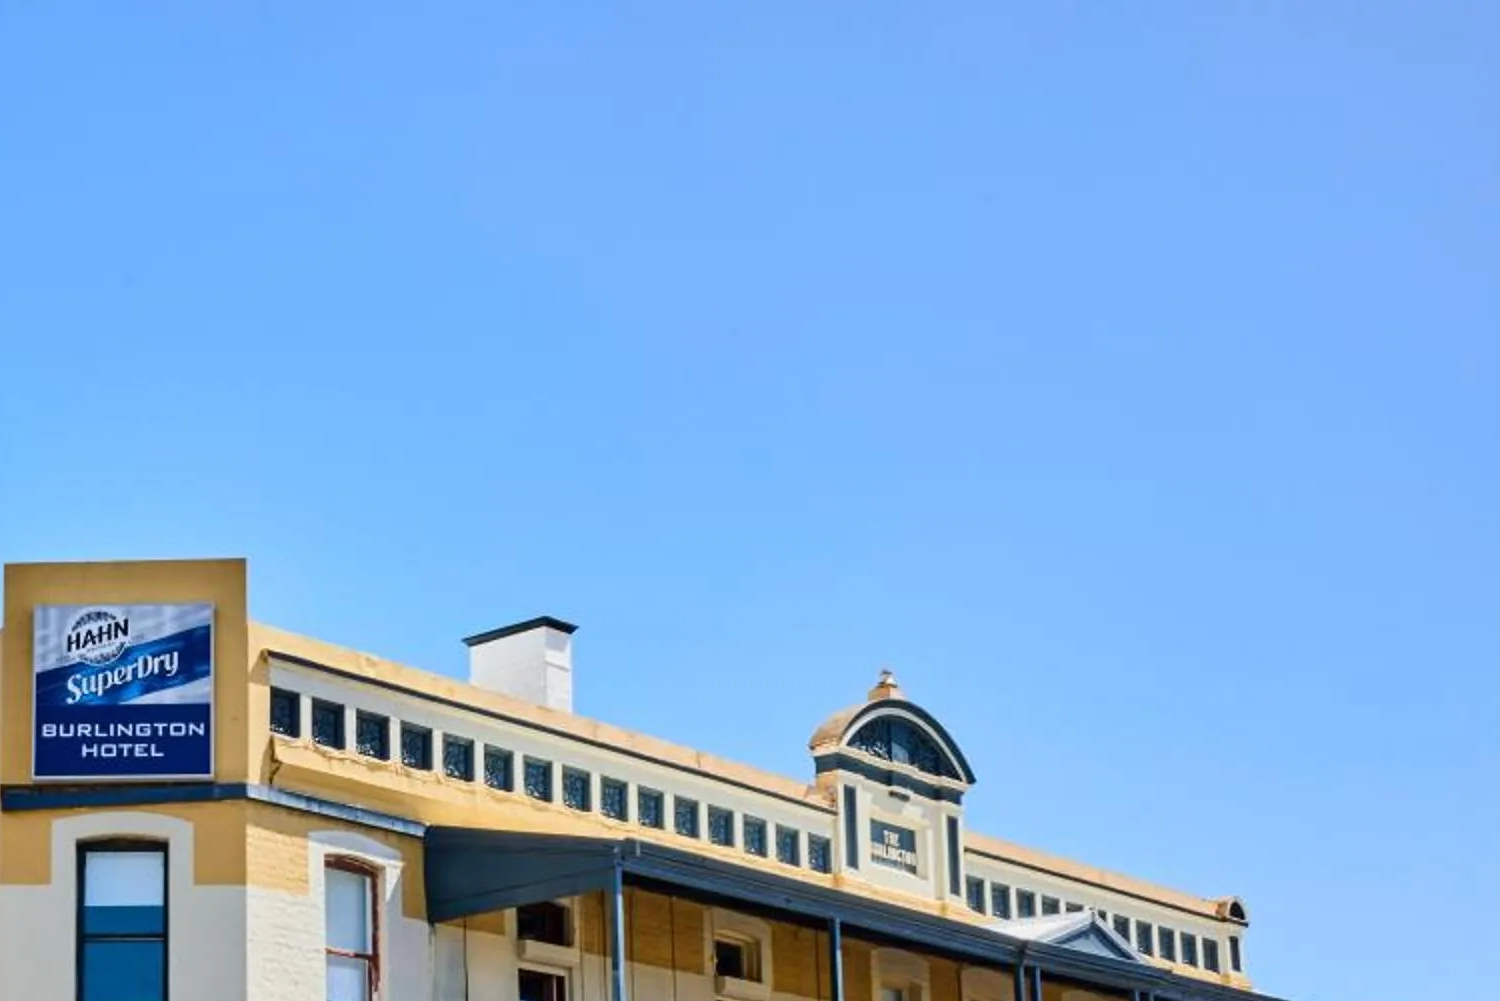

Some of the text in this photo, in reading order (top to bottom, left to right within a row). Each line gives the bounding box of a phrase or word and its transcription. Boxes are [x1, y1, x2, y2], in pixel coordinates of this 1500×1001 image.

[67, 617, 129, 652] HAHN
[66, 651, 179, 704] SuperDry
[41, 722, 205, 737] BURLINGTON
[81, 743, 165, 758] HOTEL
